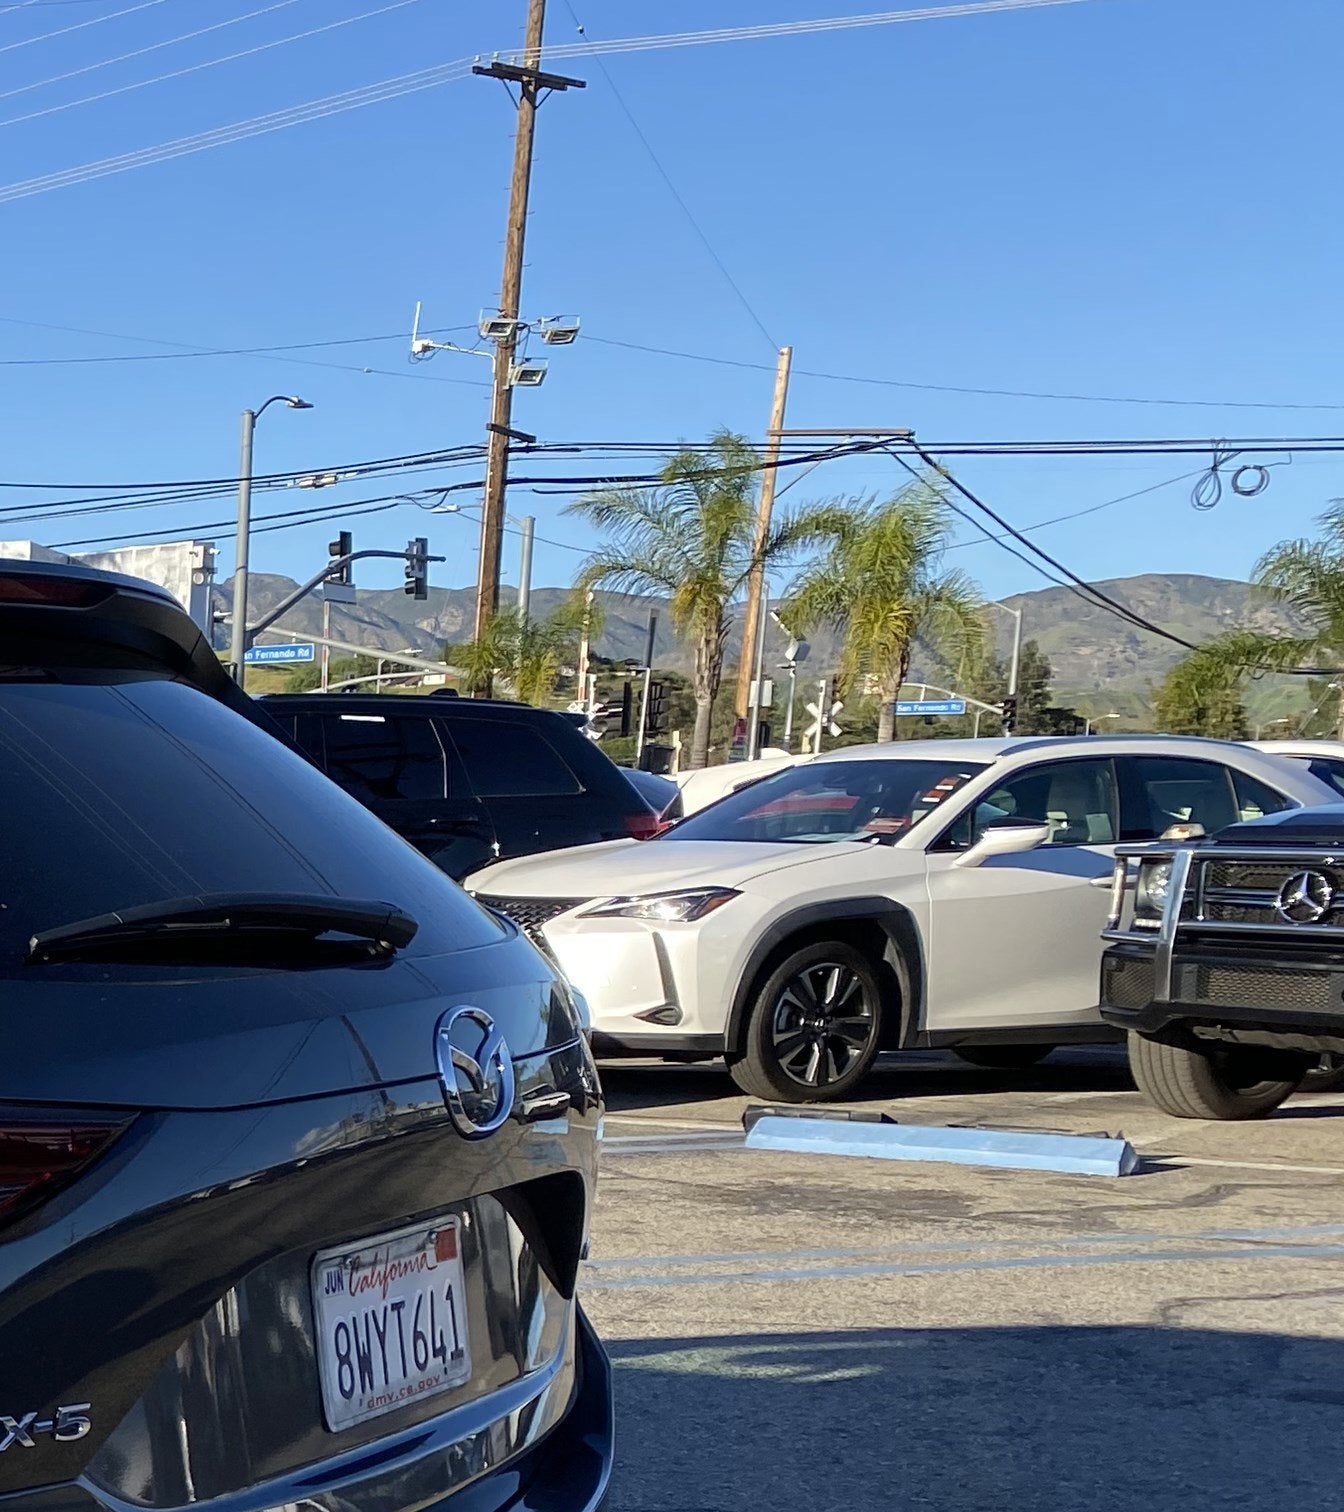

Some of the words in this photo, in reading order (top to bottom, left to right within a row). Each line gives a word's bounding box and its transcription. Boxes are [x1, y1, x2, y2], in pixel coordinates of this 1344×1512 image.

[255, 648, 295, 659] Fernando
[298, 648, 309, 657] Rd
[325, 1268, 344, 1294] JUN
[348, 1247, 438, 1299] California
[334, 1283, 464, 1401] 8WYT641
